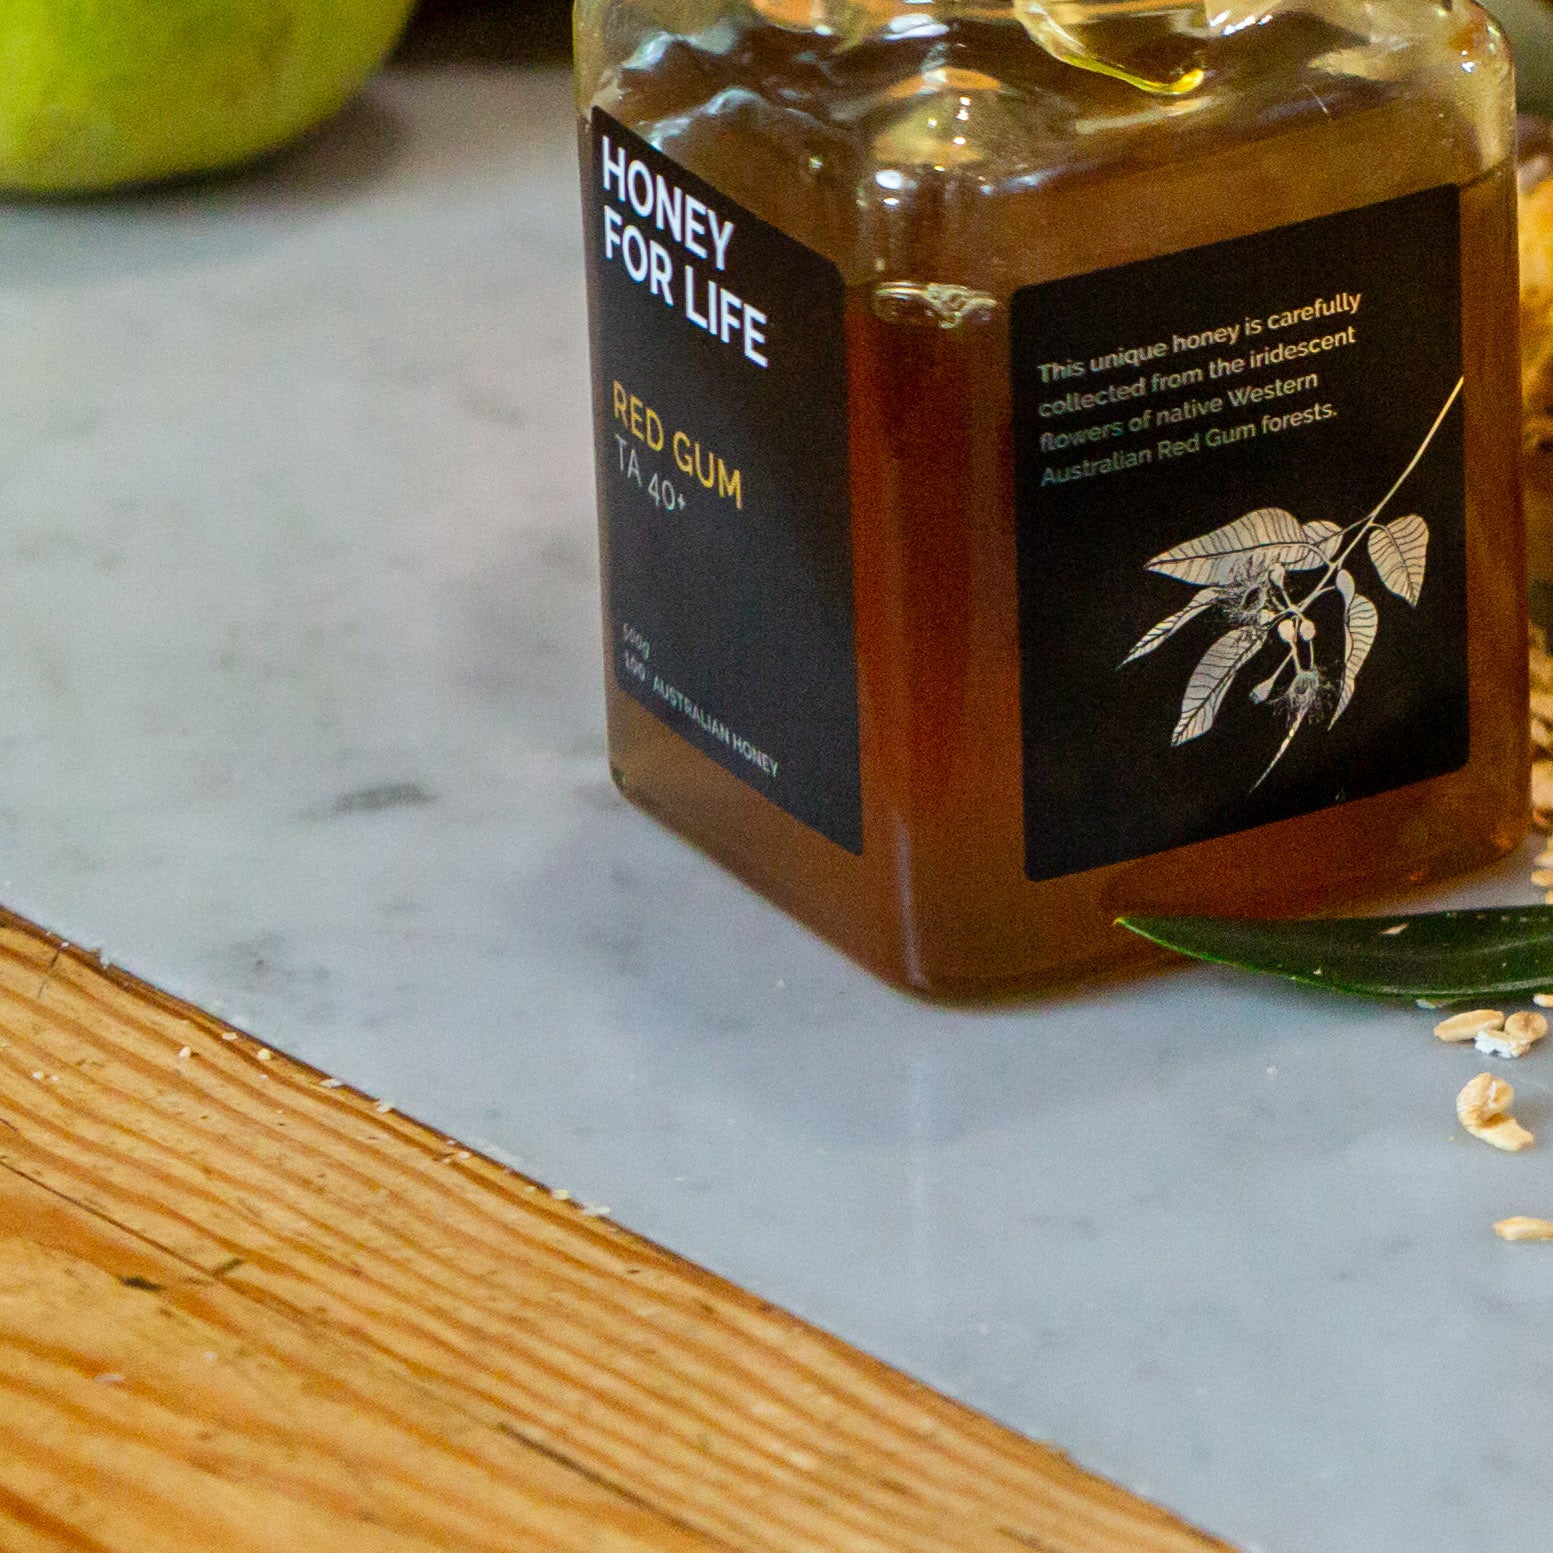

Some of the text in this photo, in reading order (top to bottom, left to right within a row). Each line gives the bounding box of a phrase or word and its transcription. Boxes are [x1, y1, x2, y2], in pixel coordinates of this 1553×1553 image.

[602, 135, 734, 271] HONEY
[604, 204, 768, 368] FOR LIFE
[1037, 292, 1361, 383] This unique honey is carefully
[1038, 326, 1356, 418] collected from the iridescent
[612, 379, 743, 511] RED GUM
[1039, 373, 1318, 452] flowers of native Western
[1040, 402, 1338, 487] Australian Red Gum forests.
[614, 433, 686, 513] TA 40+
[652, 674, 731, 745] AUSTRALIAN
[732, 732, 779, 778] HONEY
